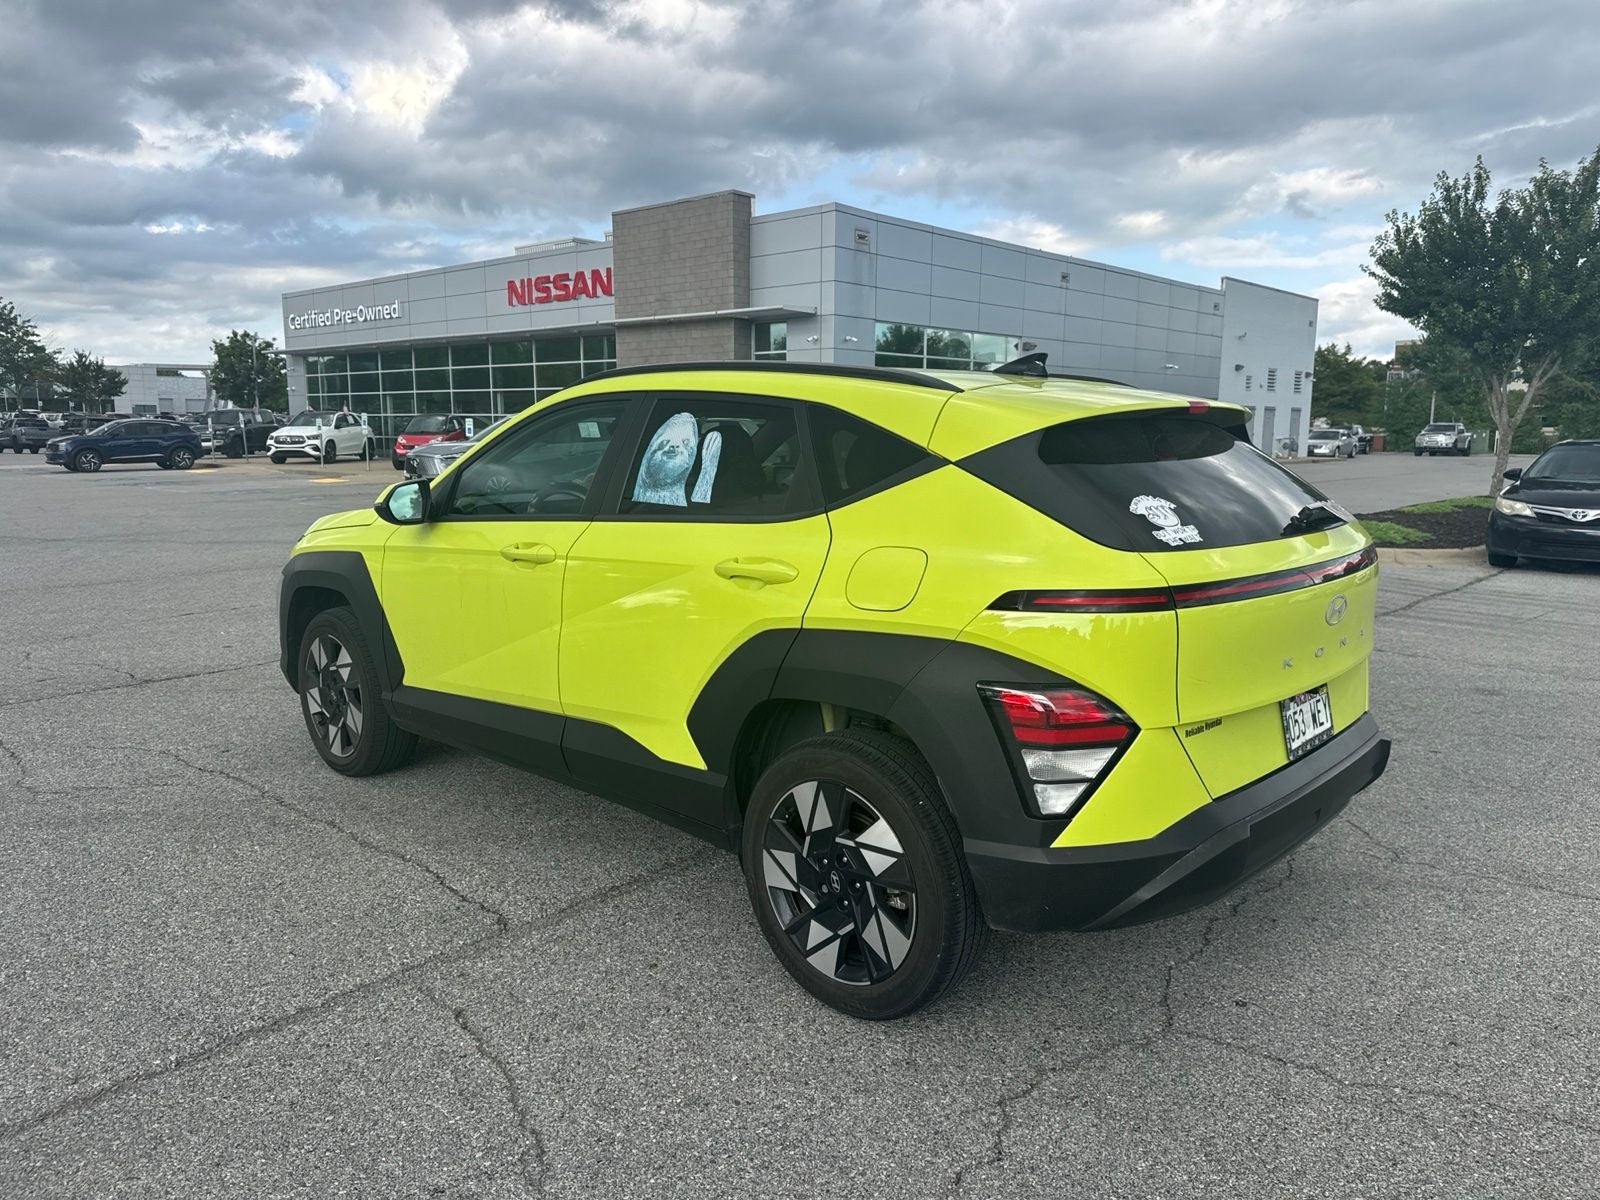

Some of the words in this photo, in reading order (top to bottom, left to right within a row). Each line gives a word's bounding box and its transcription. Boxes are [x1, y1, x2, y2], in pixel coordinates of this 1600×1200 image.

[507, 268, 613, 307] NISSAN
[288, 308, 332, 330] Certified
[334, 300, 399, 323] Pre-Owned
[1309, 695, 1329, 729] WEY
